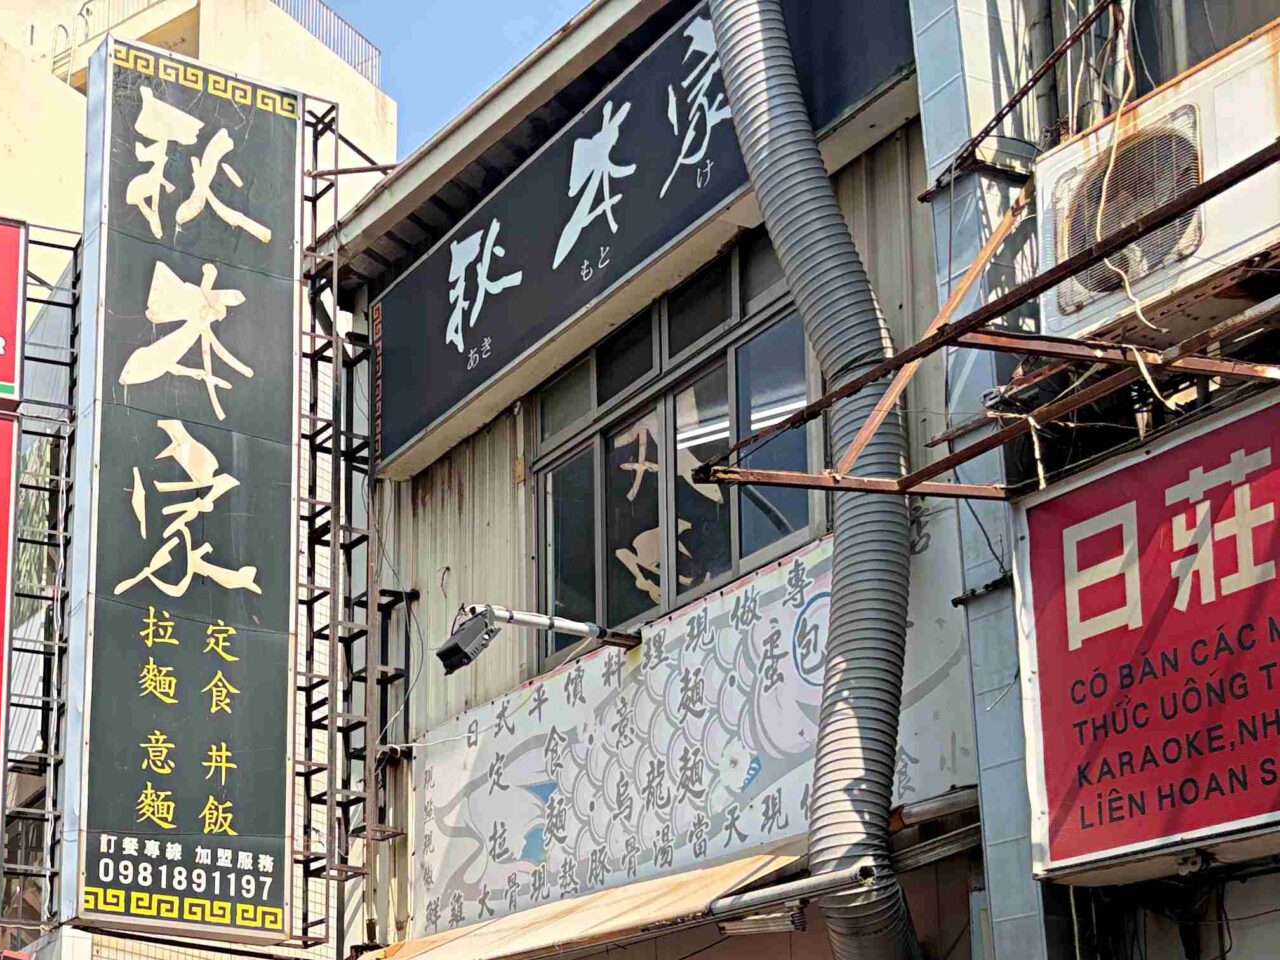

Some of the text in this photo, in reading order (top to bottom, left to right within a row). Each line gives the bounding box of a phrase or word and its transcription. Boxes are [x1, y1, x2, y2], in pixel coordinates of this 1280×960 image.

[136, 606, 179, 829] 拉麵 意麵
[198, 619, 240, 836] 定食 丼飯
[1157, 765, 1248, 811] HOAN
[99, 833, 274, 873] 訂餐專線 加盟服務
[98, 857, 273, 900] 0981891197
